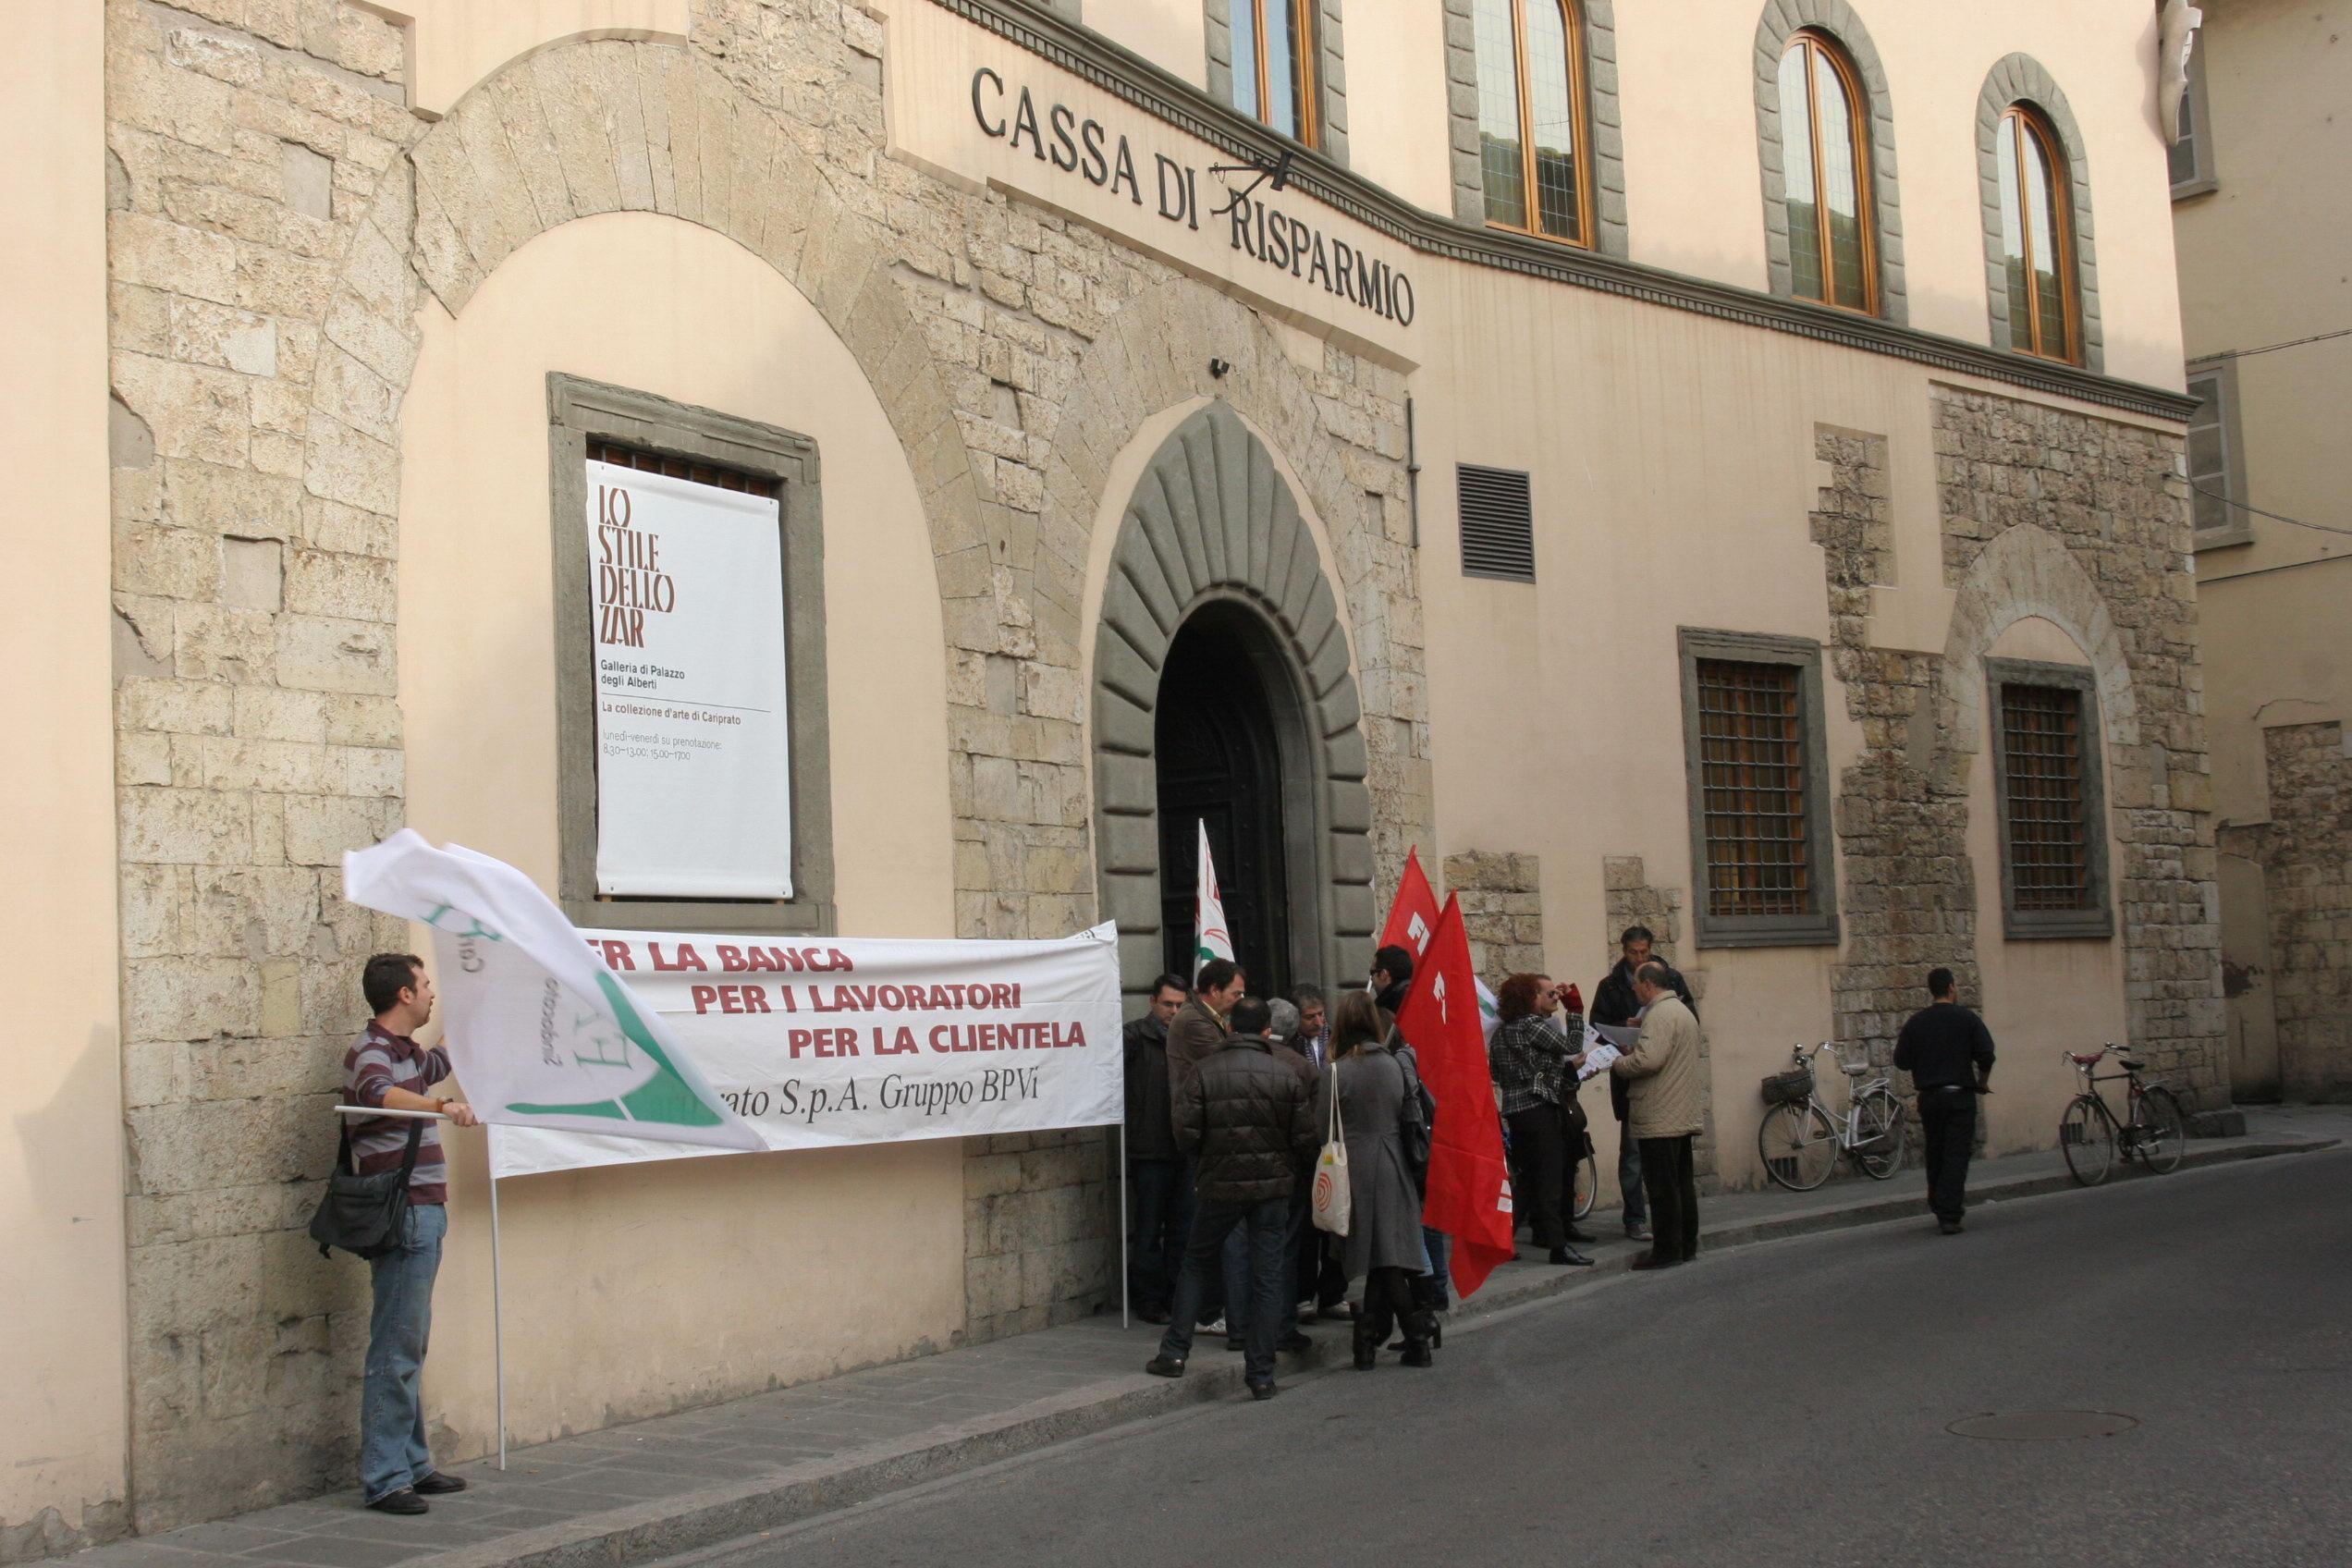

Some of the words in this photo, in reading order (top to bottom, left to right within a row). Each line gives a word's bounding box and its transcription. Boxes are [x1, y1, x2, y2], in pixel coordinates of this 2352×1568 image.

[971, 67, 1143, 205] CASSA
[1155, 152, 1200, 230] DI
[1228, 187, 1415, 327] RISPARMIO
[599, 484, 631, 528] LO
[598, 524, 660, 572] STILE
[600, 565, 675, 613] DELLO
[599, 604, 645, 648] ZAR
[601, 659, 638, 674] Galleria
[640, 664, 648, 675] di
[651, 665, 685, 680] Palazzo
[601, 674, 624, 687] degli
[627, 677, 657, 690] Alberti
[602, 701, 612, 712] La
[615, 703, 662, 717] collezione
[665, 708, 690, 720] d'arte
[692, 710, 700, 721] di
[702, 711, 741, 727] Cariprato
[662, 736, 671, 745] su
[648, 941, 708, 972] LA
[716, 944, 853, 972] BANCA
[691, 986, 771, 1014] PER
[781, 985, 797, 1013] I
[808, 983, 1022, 1012] LAVORATORI
[788, 1028, 860, 1059] PER
[873, 1025, 919, 1055] LA
[928, 1021, 1087, 1053] CLIENTELA
[779, 1076, 867, 1124] S.p.A.
[879, 1073, 974, 1116] Gruppo
[980, 1066, 1039, 1103] BPVi
